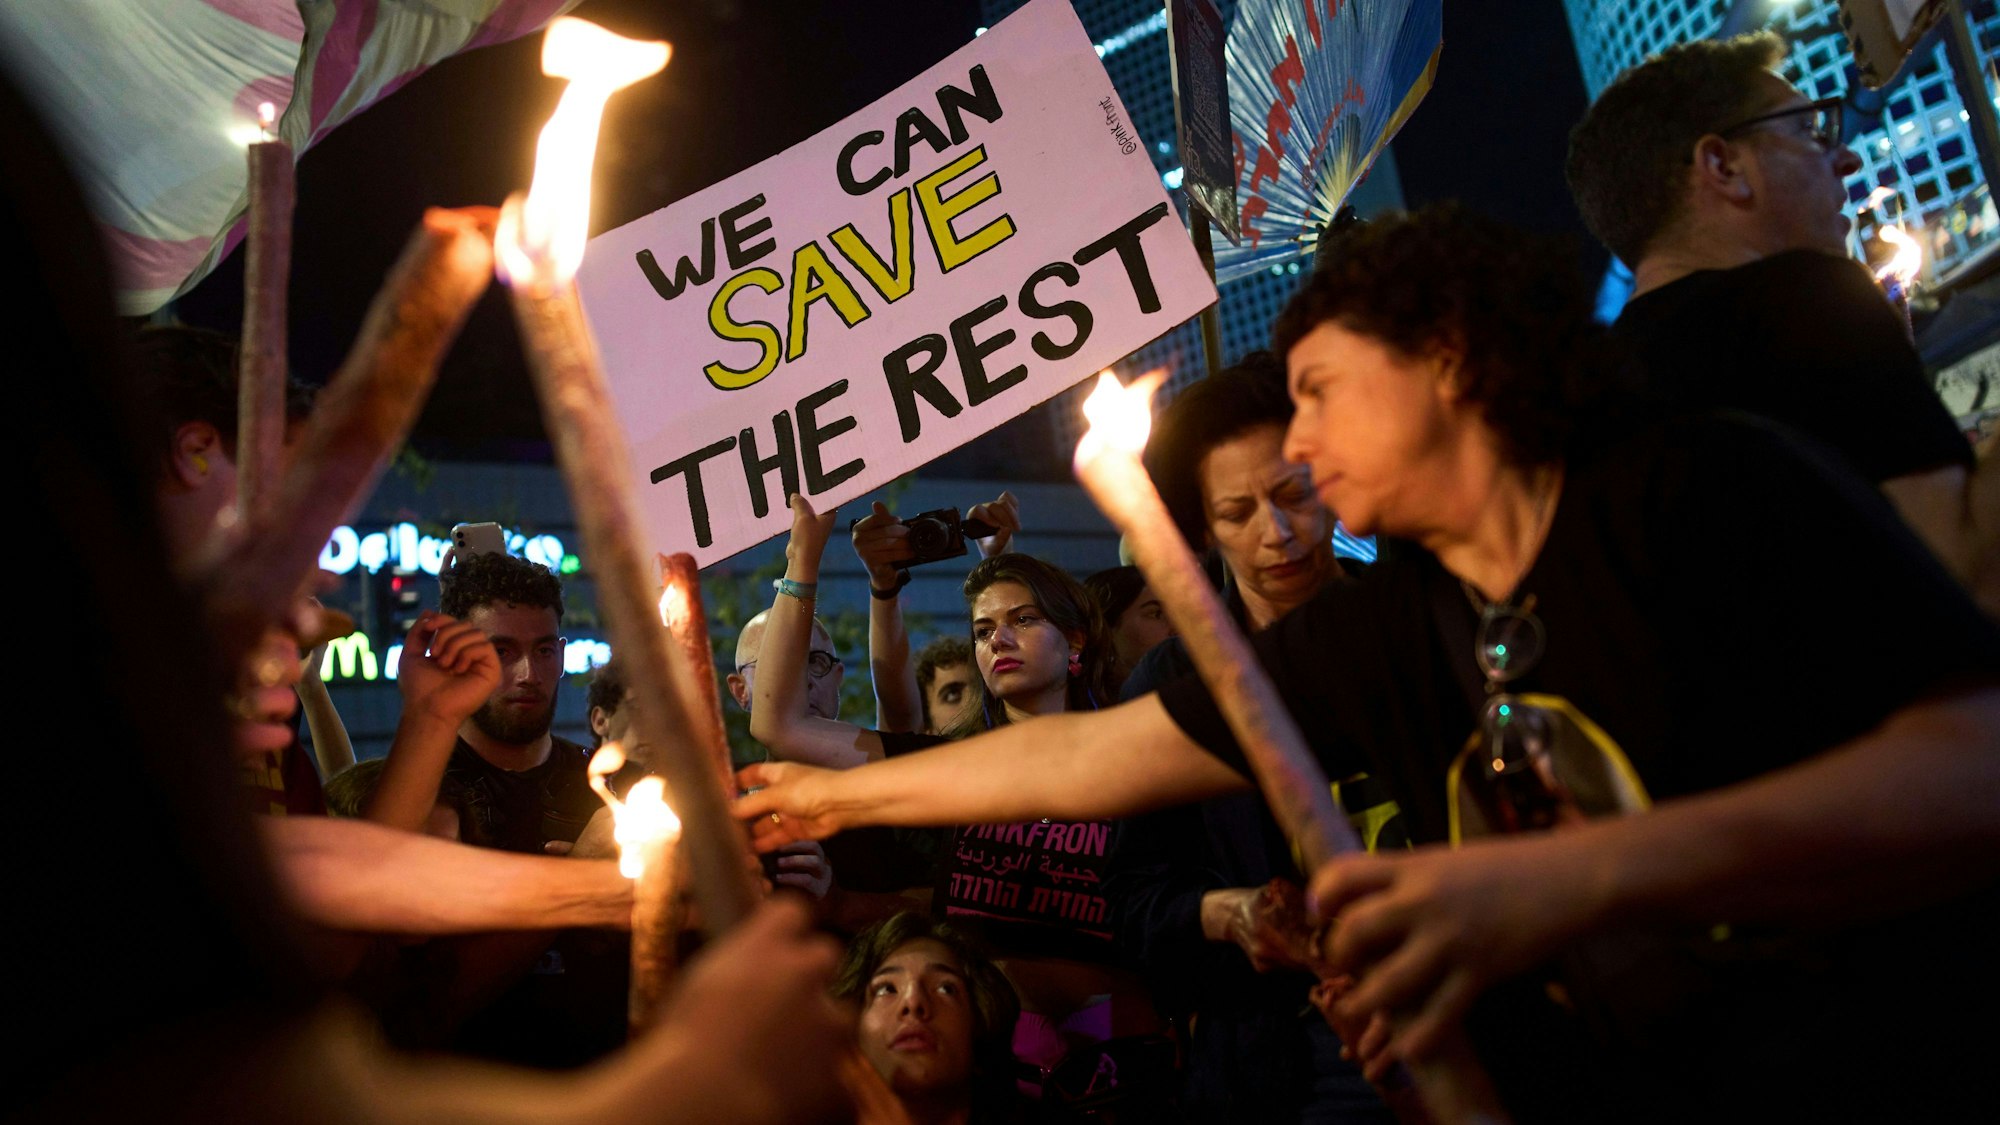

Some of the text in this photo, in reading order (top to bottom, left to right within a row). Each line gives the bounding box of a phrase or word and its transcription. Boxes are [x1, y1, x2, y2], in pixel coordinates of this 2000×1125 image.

[636, 64, 1003, 301] WE CAN
[702, 144, 1017, 391] SAVE
[650, 202, 1169, 548] THE REST
[949, 872, 1108, 924] החזית הורודה
